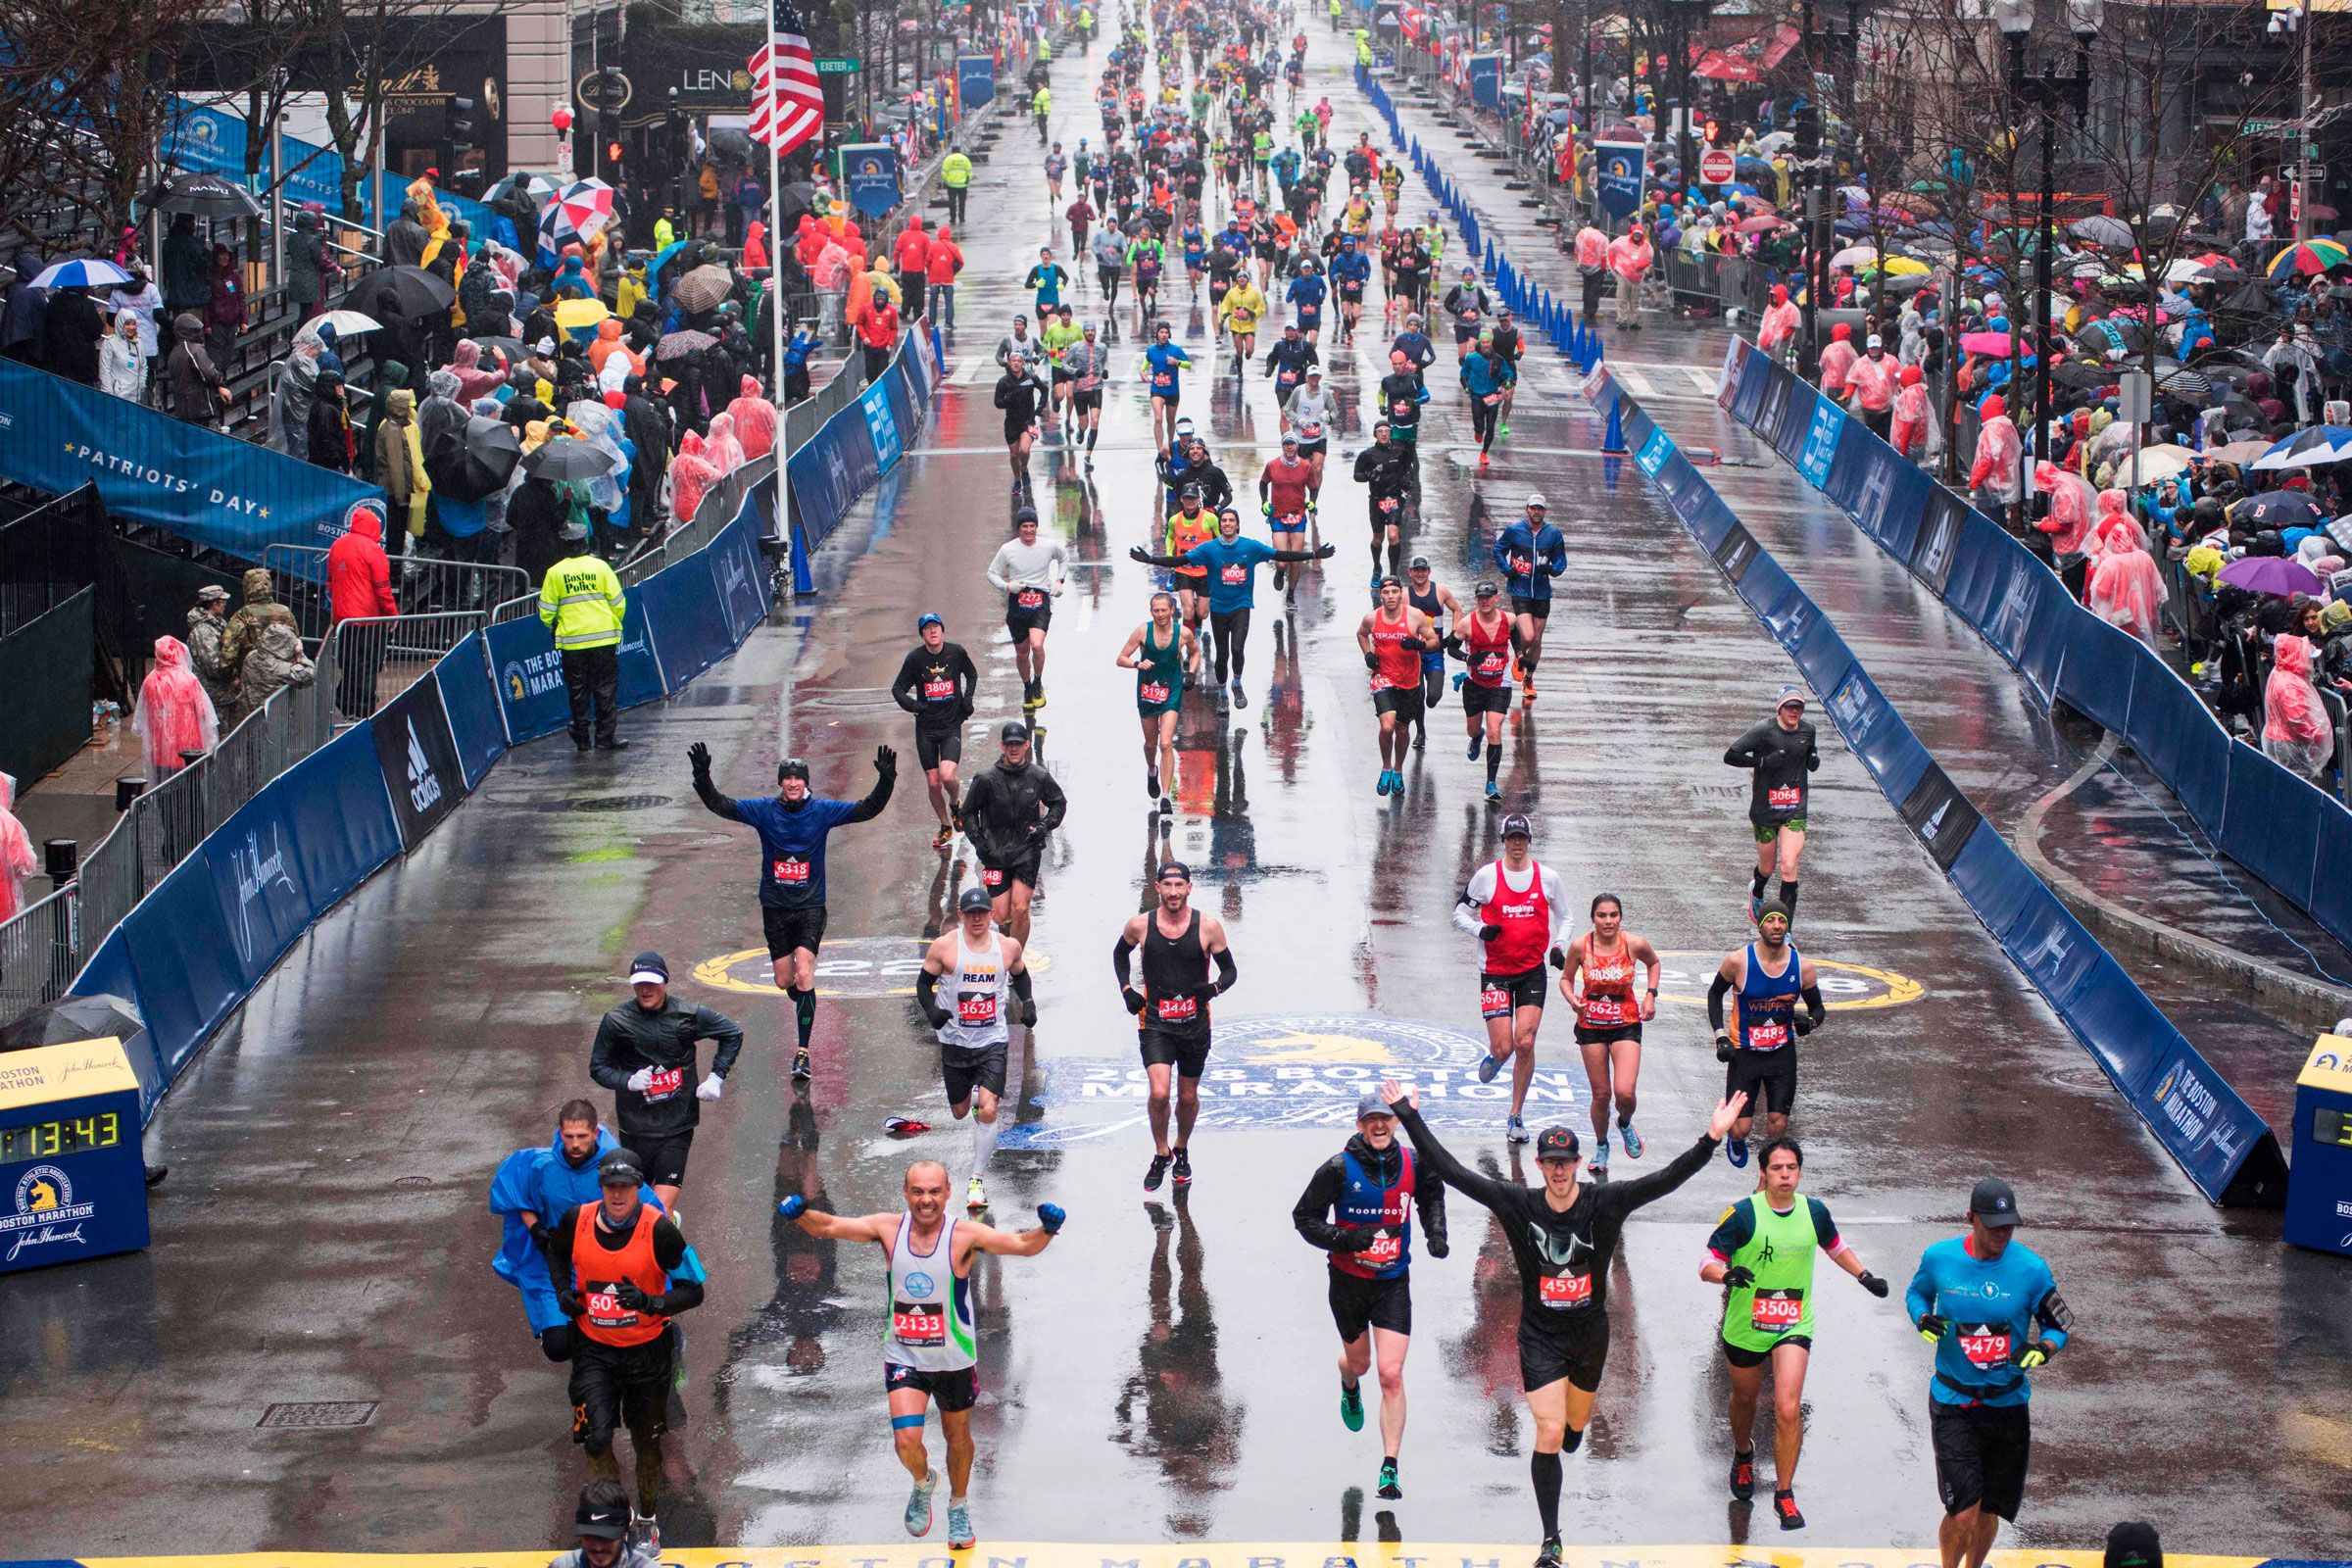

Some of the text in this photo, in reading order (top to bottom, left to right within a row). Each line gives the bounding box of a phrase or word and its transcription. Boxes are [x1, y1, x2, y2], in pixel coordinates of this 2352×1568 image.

[820, 61, 848, 72] EXETER
[210, 489, 258, 515] DAY
[318, 523, 348, 537] BOSTO
[564, 571, 597, 585] Boston
[565, 582, 598, 594] Police
[524, 655, 544, 675] THE
[530, 668, 564, 696] MARA
[927, 680, 952, 693] 3809
[1143, 685, 1166, 698] 5196
[411, 772, 441, 813] adidas
[1772, 788, 1797, 801] 3068
[777, 861, 807, 875] 6318
[964, 963, 997, 973] TEAM
[962, 973, 996, 983] REAM
[960, 1001, 993, 1014] 3628
[1163, 999, 1195, 1013] 3442
[1589, 1002, 1621, 1015] 6625
[1752, 1027, 1784, 1041] 6489
[0, 1065, 40, 1080] OSTON
[651, 1070, 679, 1086] 418
[1083, 1065, 1570, 1086] 208 BOSTON
[2186, 1080, 2218, 1119] BOSTON
[2163, 1091, 2205, 1142] MARATHON
[0, 1112, 118, 1162] :13:43
[23, 1167, 50, 1187] ATHLETIC
[49, 1168, 71, 1204] ASSOCIATION
[38, 1204, 94, 1223] MARATHON
[7, 1223, 86, 1261] John Hancock
[1370, 1240, 1397, 1255] 604
[1544, 1276, 1588, 1293] 4597
[1757, 1300, 1798, 1316] 3506
[898, 1314, 940, 1332] 2133
[1960, 1337, 2006, 1354] 5479
[1100, 1556, 1641, 1568] MARATHN
